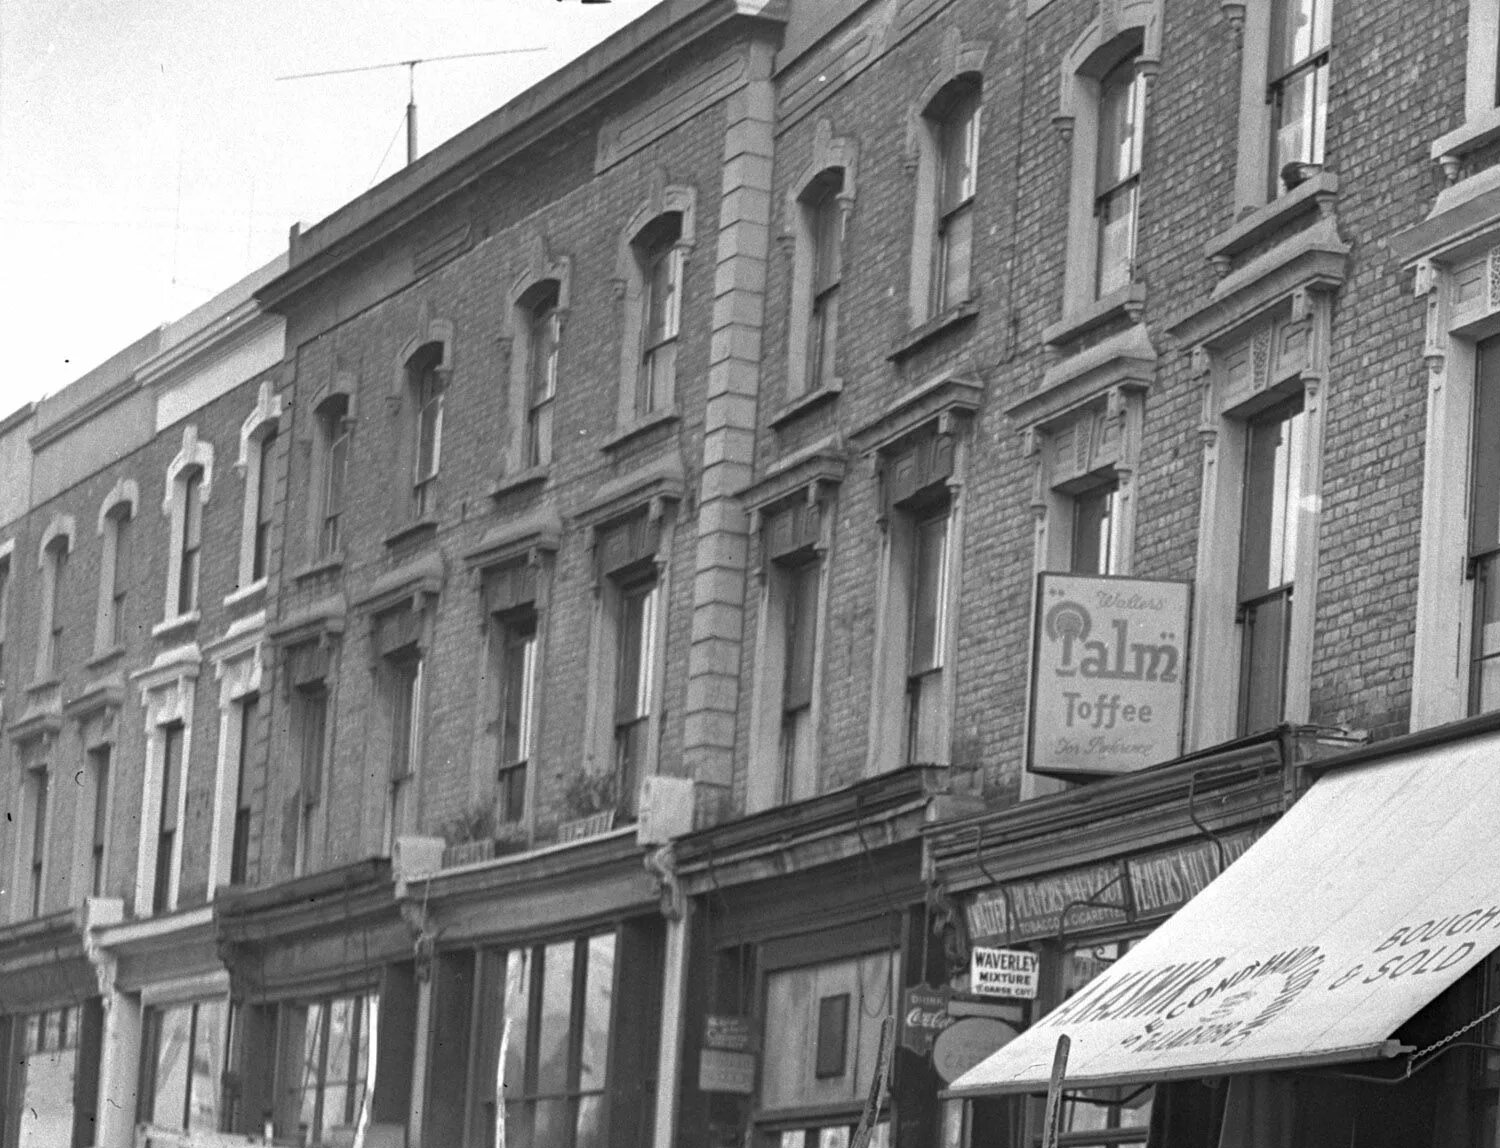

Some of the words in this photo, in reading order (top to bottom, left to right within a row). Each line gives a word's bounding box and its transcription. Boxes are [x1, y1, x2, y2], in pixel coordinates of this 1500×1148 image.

[1046, 600, 1180, 683] Palm
[1062, 692, 1153, 729] Toffee
[1019, 919, 1060, 935] TOBACCO
[975, 951, 1038, 973] WAVERLEY
[1328, 964, 1363, 990] &
[1363, 942, 1476, 984] SOLD
[980, 972, 1031, 985] MIXTURE
